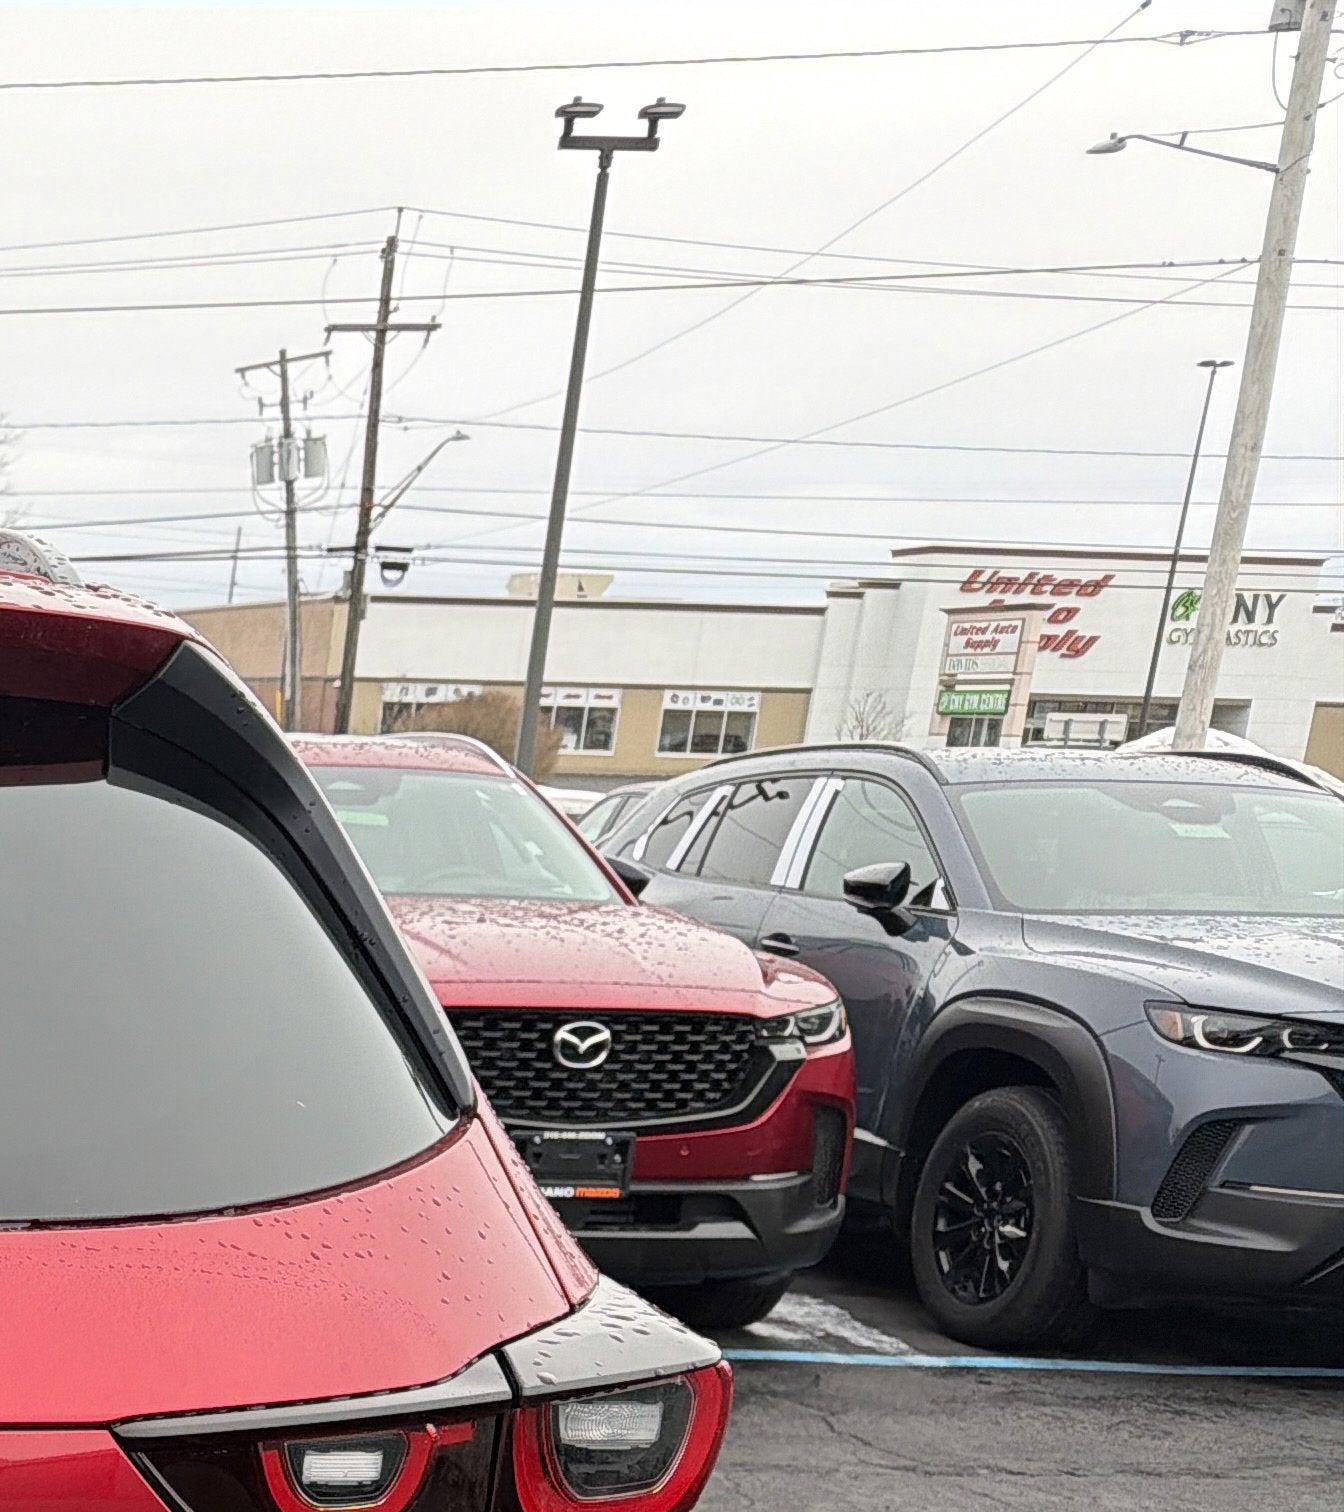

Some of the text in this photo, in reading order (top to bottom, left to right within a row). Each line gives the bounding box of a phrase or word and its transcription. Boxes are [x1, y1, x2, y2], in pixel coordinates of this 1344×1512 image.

[960, 569, 1116, 597] United
[1230, 593, 1287, 625] NY
[953, 623, 1018, 636] United Auto
[963, 637, 1001, 651] Supply
